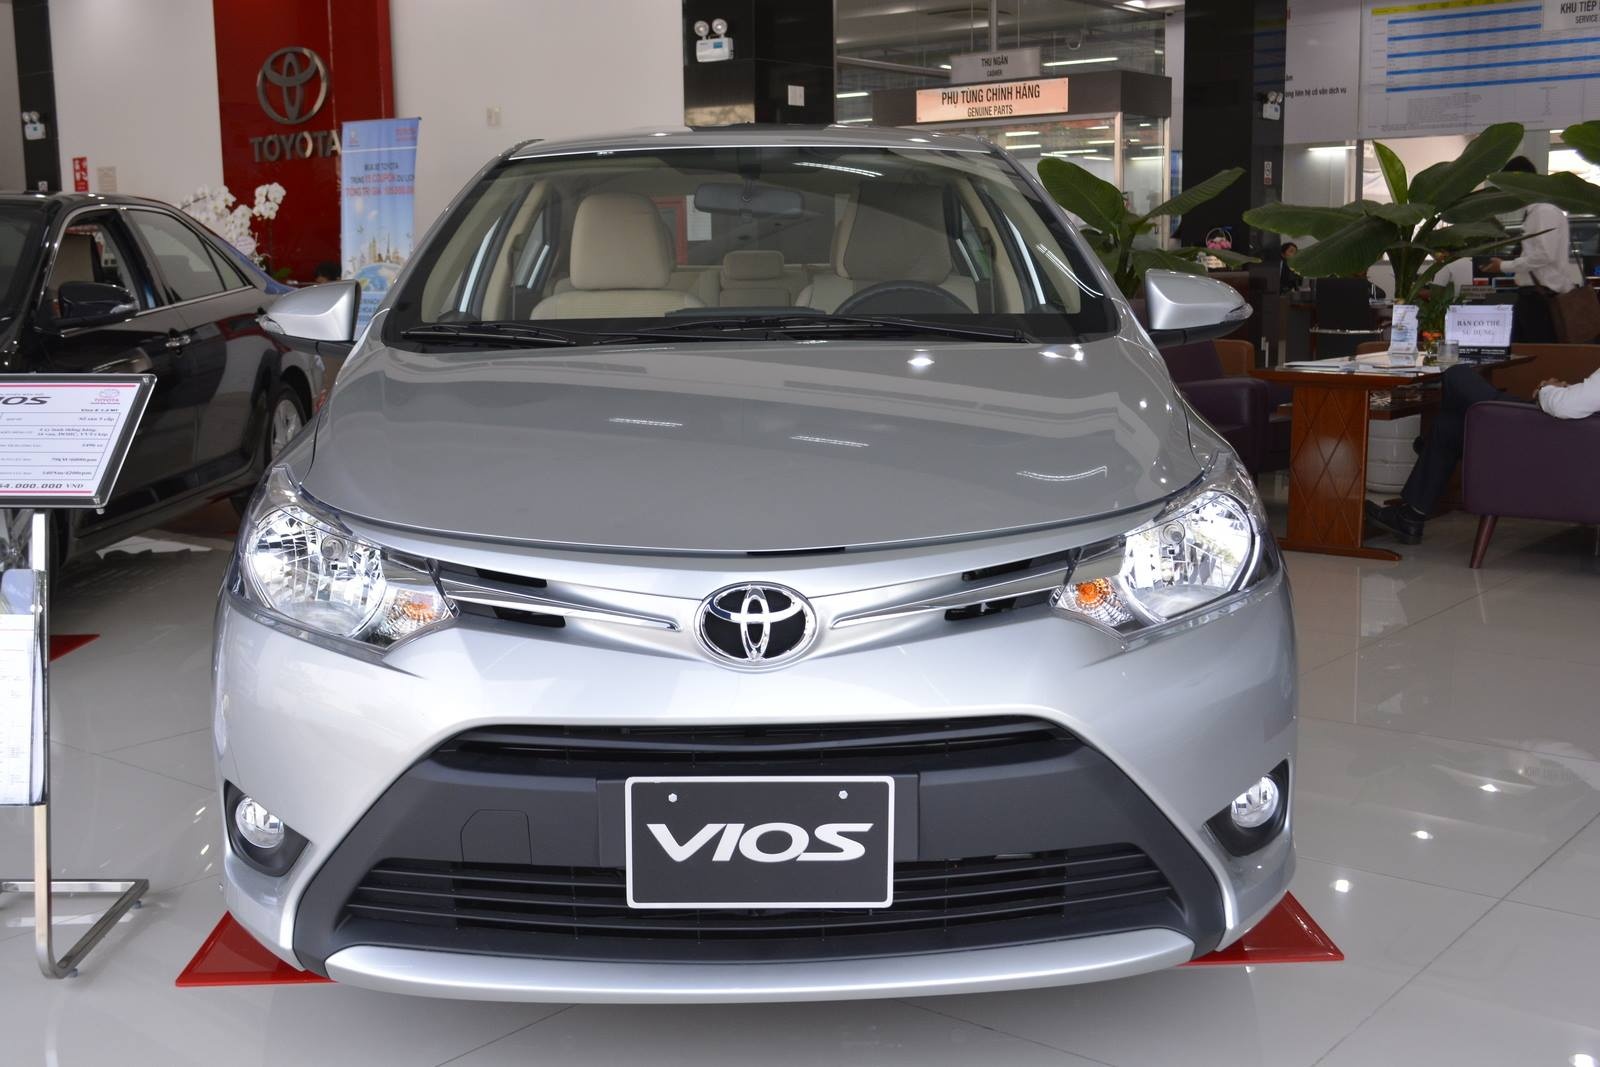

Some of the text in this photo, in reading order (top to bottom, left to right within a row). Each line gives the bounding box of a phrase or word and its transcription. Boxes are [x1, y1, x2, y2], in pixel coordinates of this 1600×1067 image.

[1560, 2, 1577, 14] KHU
[1575, 14, 1598, 24] SERVICE
[981, 57, 992, 67] THU
[941, 83, 1040, 108] PHỤ TÙNG CHÍNH HÃNG
[967, 104, 1013, 118] GENUINE PARTS
[250, 129, 341, 162] TOYOTA
[0, 396, 52, 405] OS
[646, 822, 874, 863] VIOS
